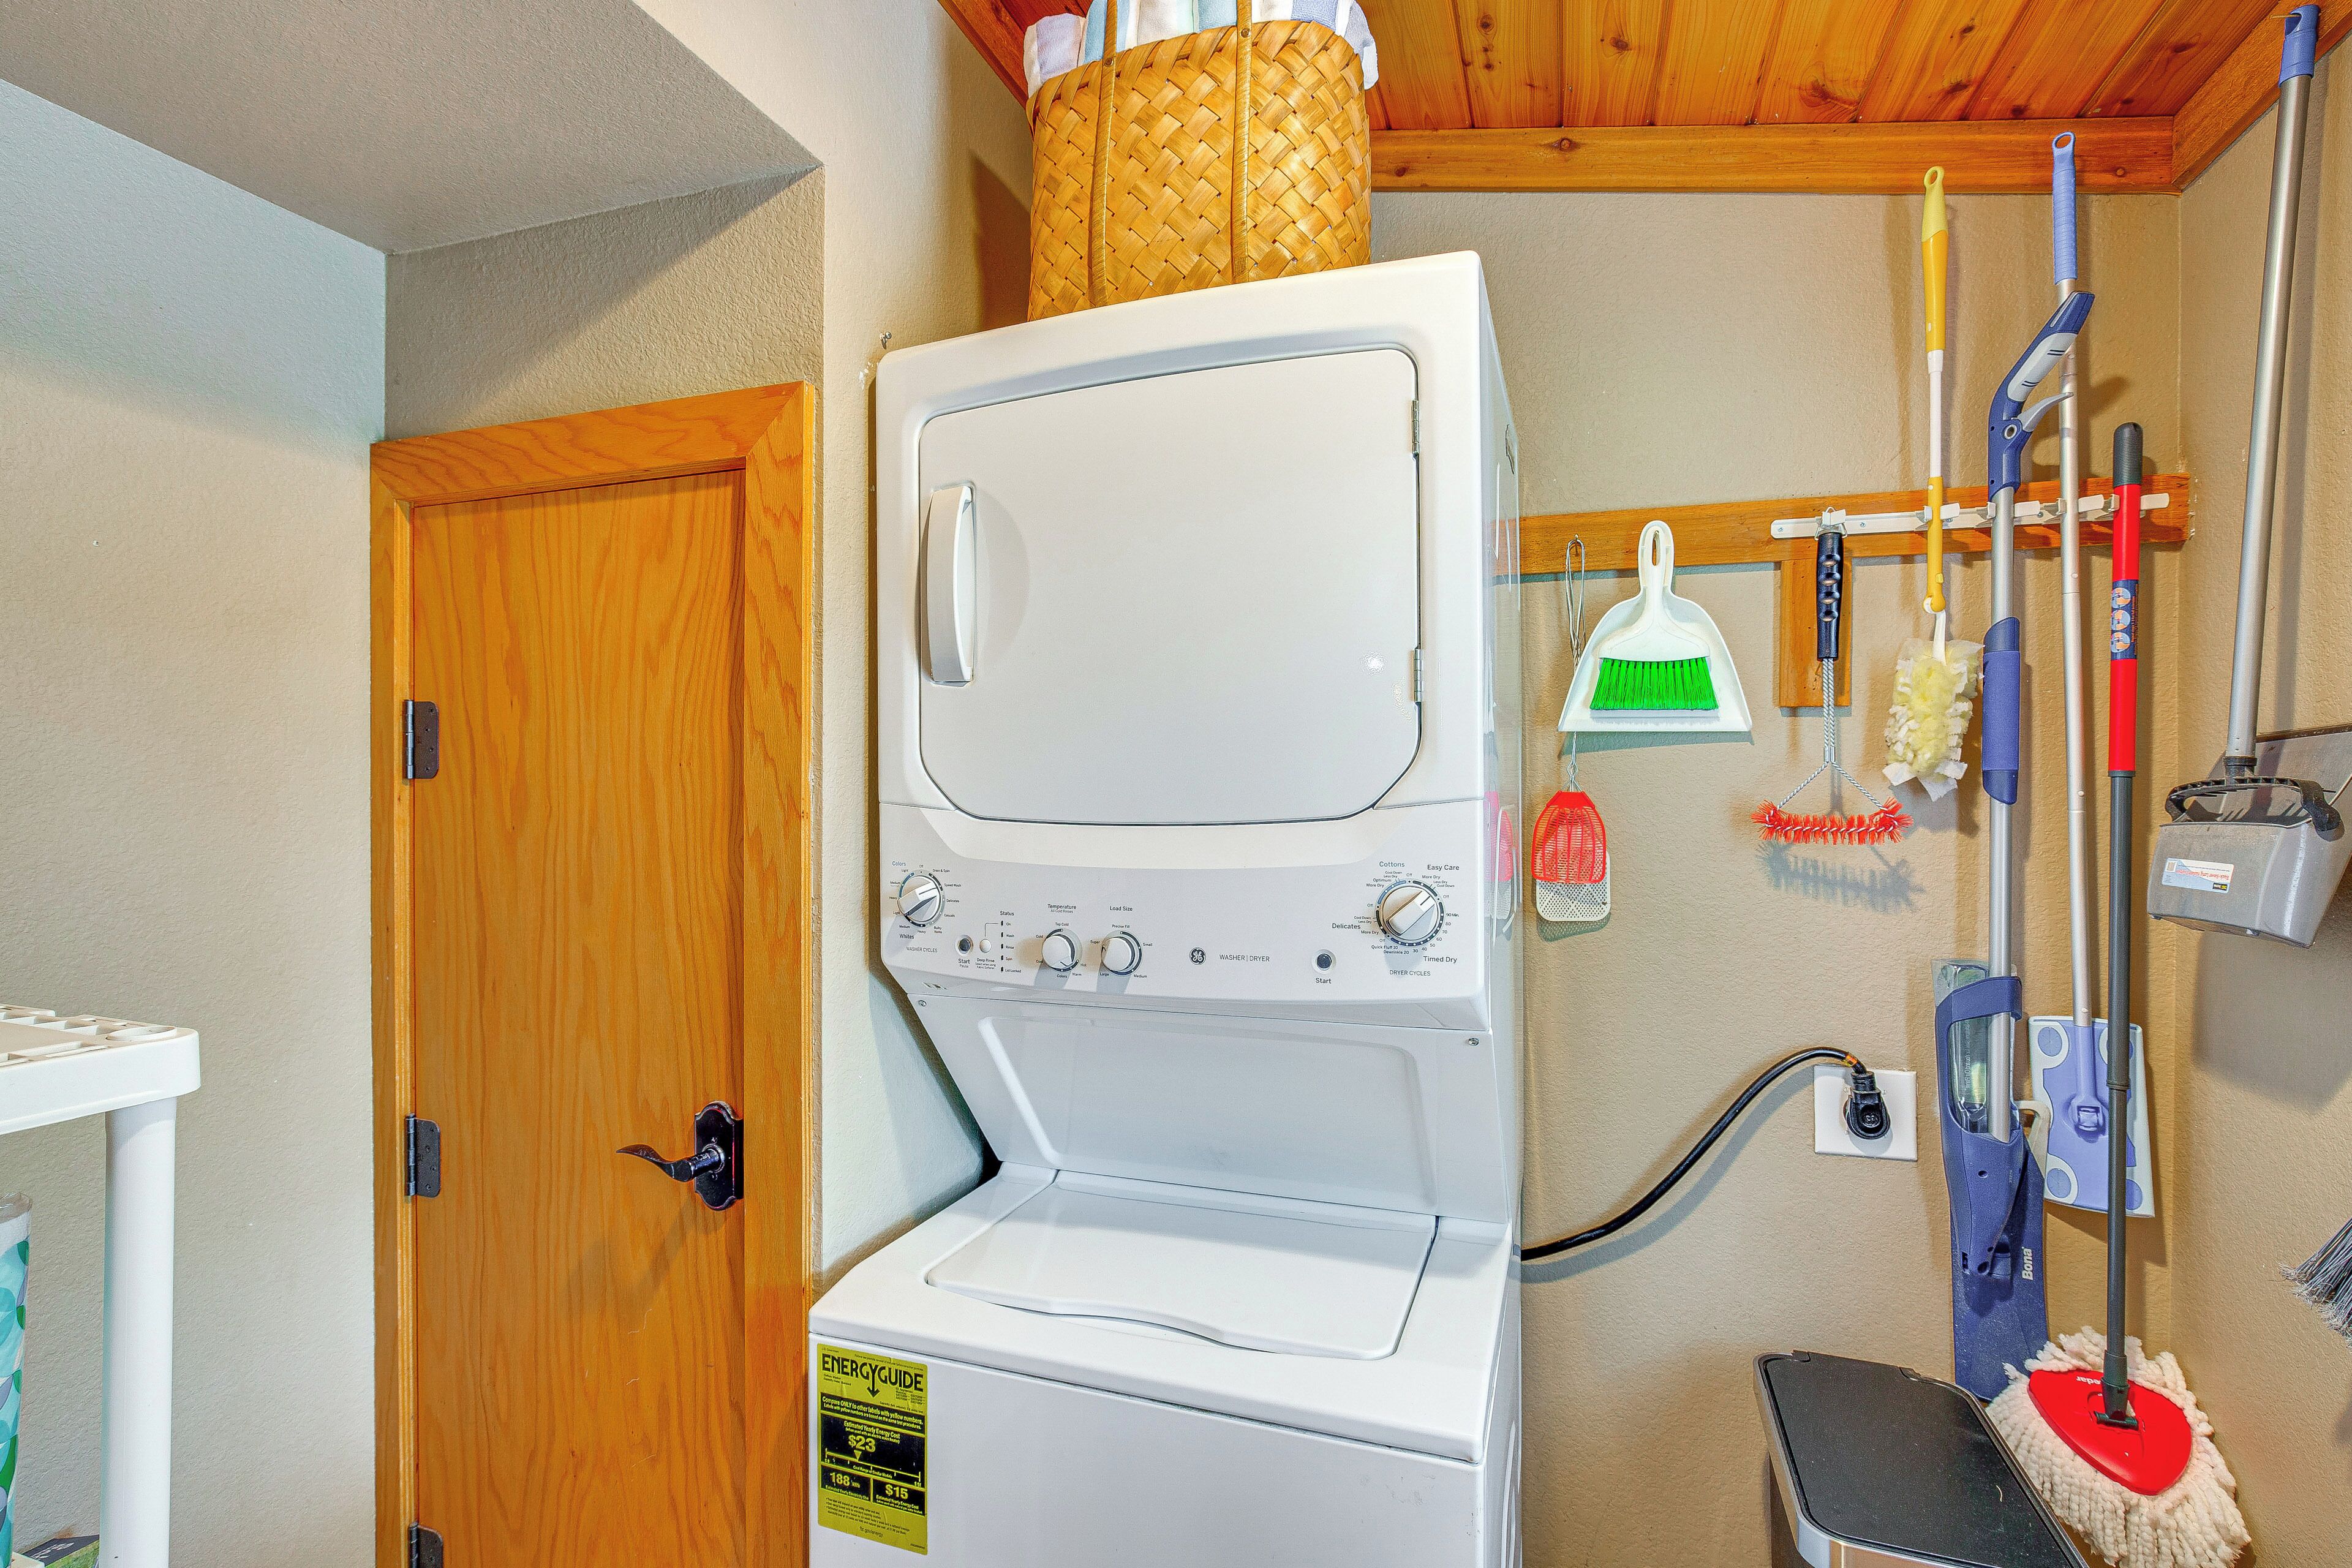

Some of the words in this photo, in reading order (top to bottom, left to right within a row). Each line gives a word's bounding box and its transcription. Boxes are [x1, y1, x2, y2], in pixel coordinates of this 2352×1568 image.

[2022, 1248, 2034, 1280] Bona
[821, 1353, 924, 1393] ENERGYGUIDE
[2076, 1376, 2101, 1385] edar
[822, 1396, 840, 1406] Compare
[889, 1411, 903, 1421] yellow
[903, 1415, 922, 1425] numbers.
[843, 1420, 863, 1430] Estimated
[863, 1425, 875, 1434] Yearly
[876, 1428, 889, 1438] Energy
[848, 1434, 876, 1452] $23
[830, 1472, 850, 1487] 188
[885, 1483, 908, 1499] $15
